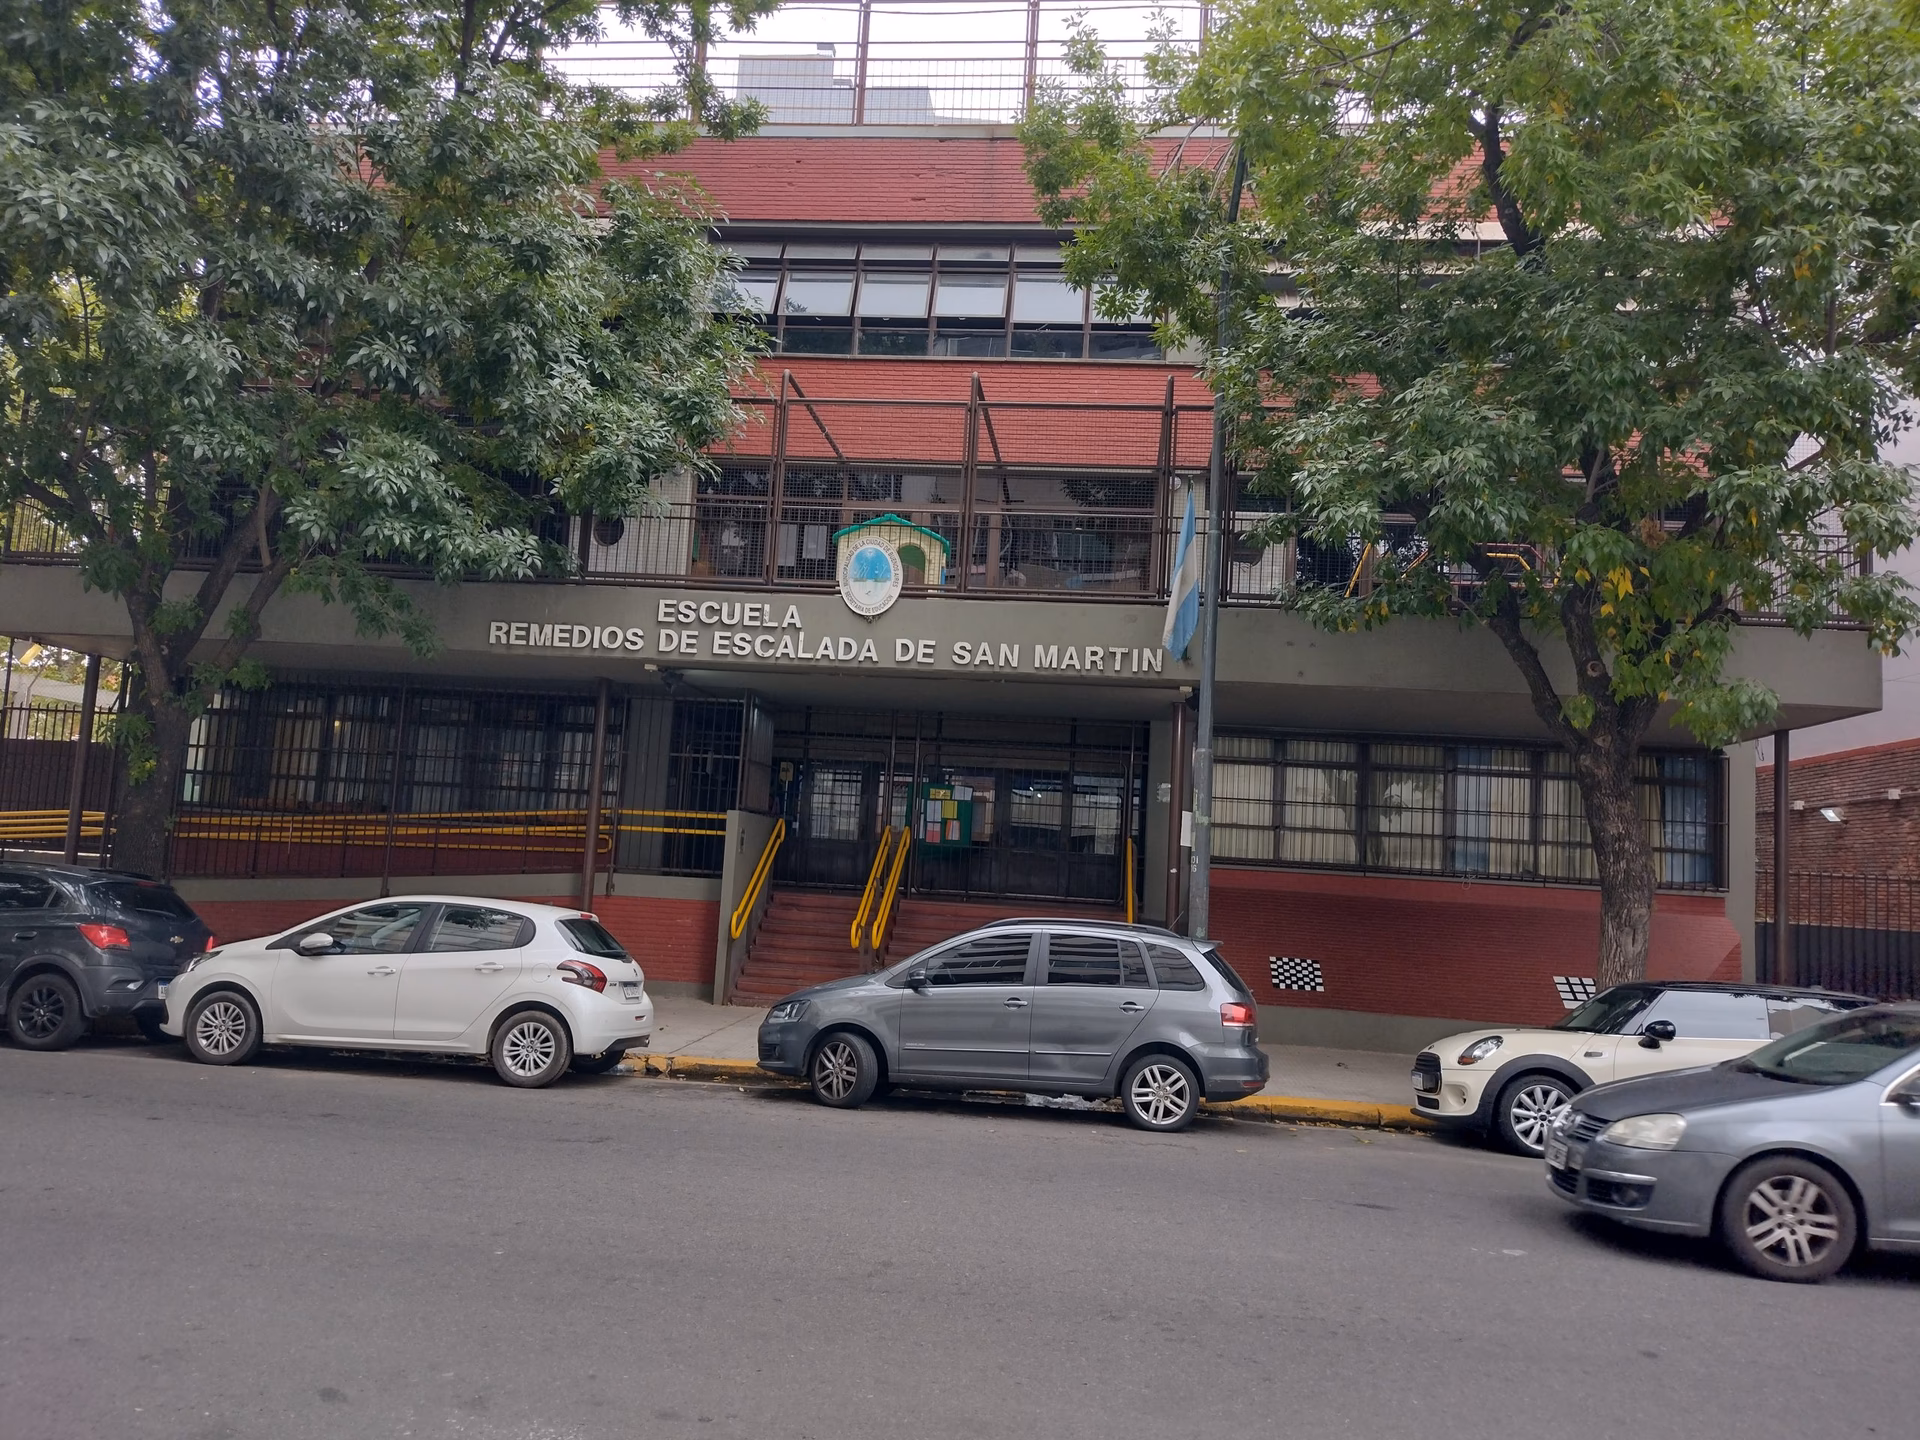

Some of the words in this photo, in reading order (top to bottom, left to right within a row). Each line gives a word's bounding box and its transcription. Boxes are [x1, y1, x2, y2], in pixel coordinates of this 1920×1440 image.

[852, 544, 860, 552] DE
[866, 539, 885, 547] CIUDAD
[883, 544, 891, 552] DE
[888, 552, 899, 572] BUENOS
[892, 572, 900, 588] AIRES
[657, 599, 802, 629] ESCUELA
[489, 621, 645, 651] REMEDIOS
[658, 628, 699, 655] DE
[712, 631, 879, 663] ESCALADA
[895, 638, 936, 664] DE
[951, 641, 1020, 669] SAN
[1034, 644, 1164, 673] MARTIN
